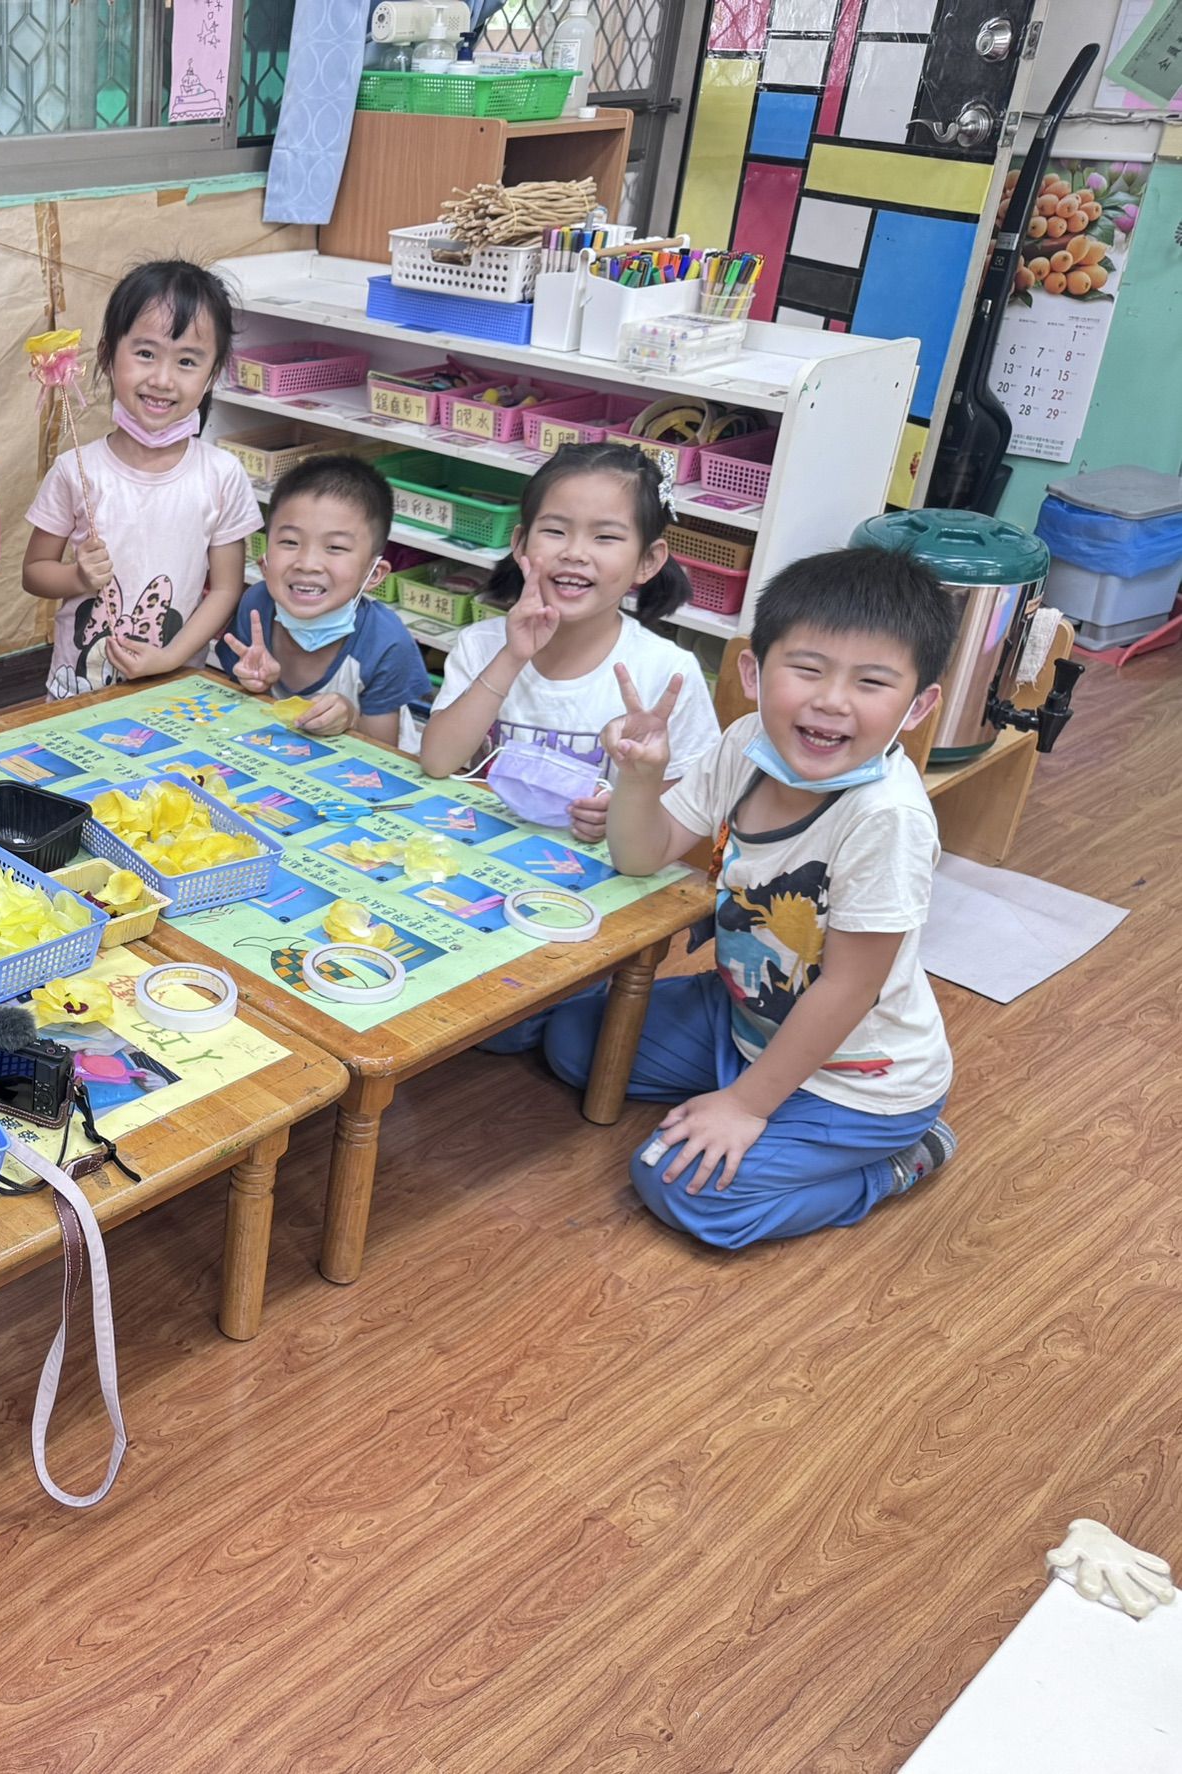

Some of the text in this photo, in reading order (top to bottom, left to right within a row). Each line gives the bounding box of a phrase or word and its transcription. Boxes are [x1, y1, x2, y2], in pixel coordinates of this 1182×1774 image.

[1072, 330, 1077, 342] 1
[1009, 344, 1072, 362] 6 7 8
[1003, 362, 1070, 382] 13 14 15
[997, 381, 1065, 400] 20 21 22
[1018, 404, 1060, 420] 28 29
